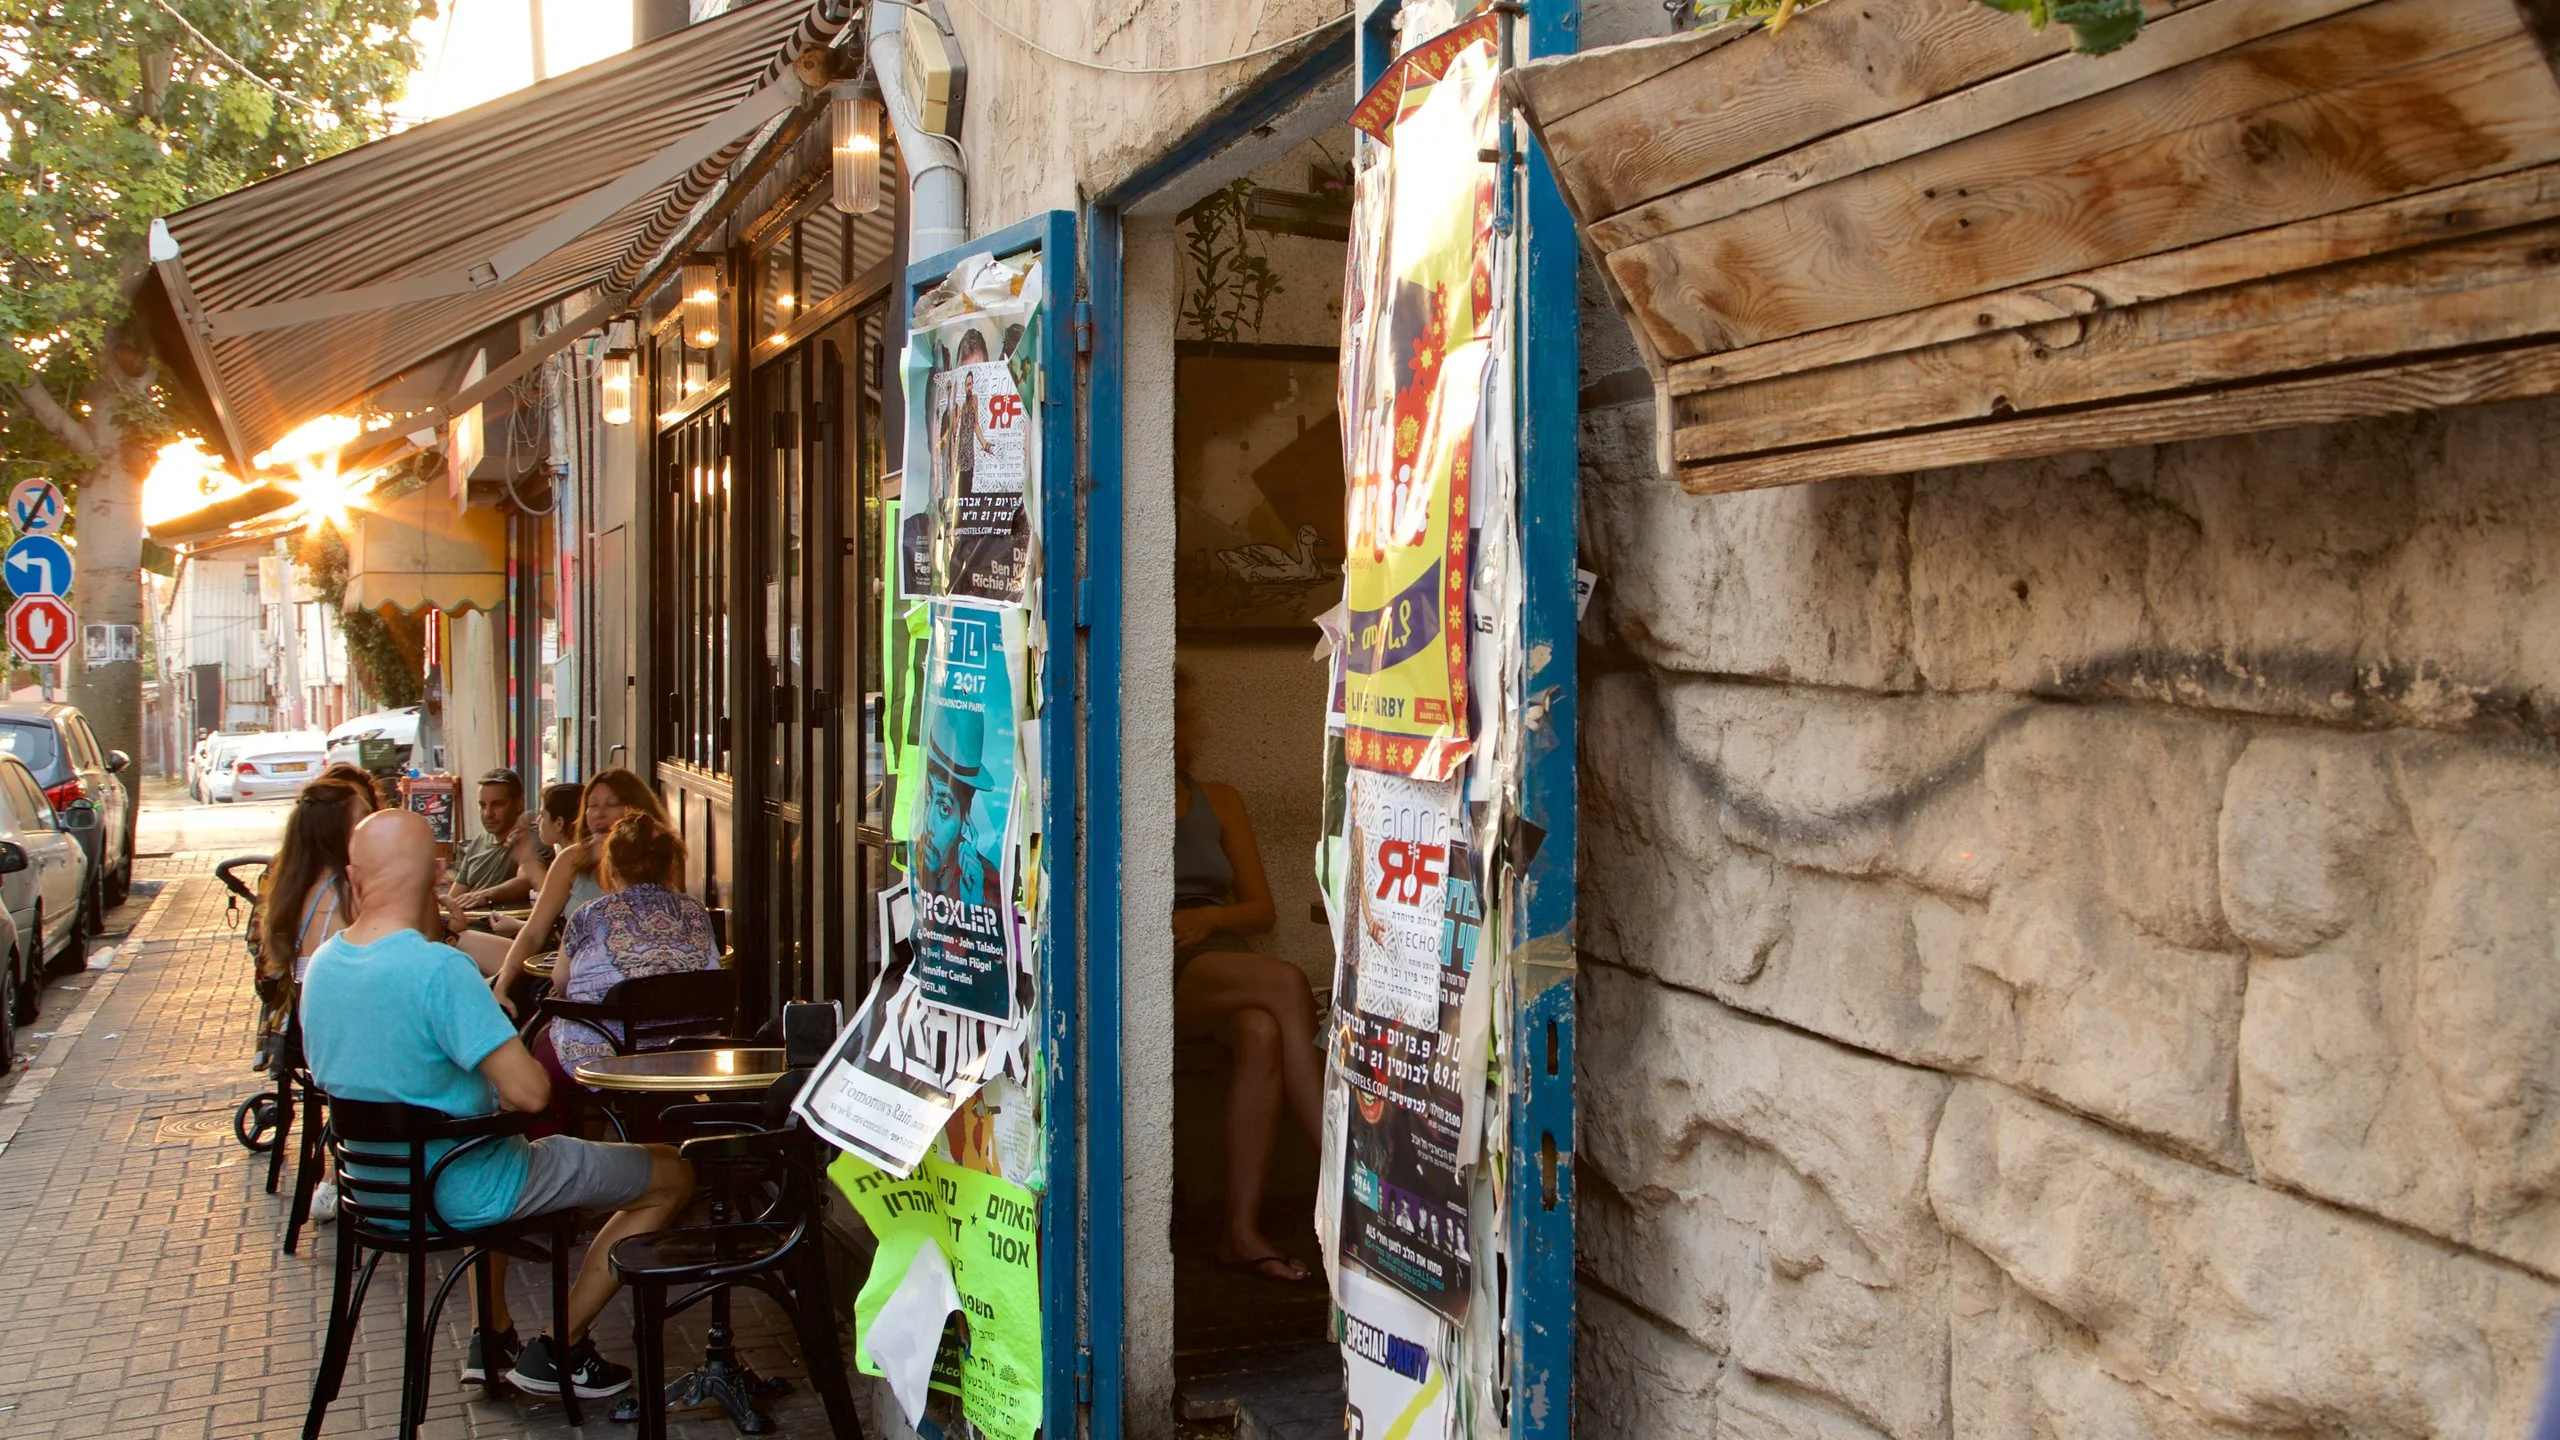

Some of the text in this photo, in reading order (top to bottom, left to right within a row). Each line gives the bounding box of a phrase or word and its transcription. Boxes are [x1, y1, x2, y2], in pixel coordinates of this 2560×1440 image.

[991, 560, 1010, 576] Ben
[972, 573, 1005, 592] Richie
[953, 671, 986, 694] 2017
[1380, 801, 1447, 848] anna
[920, 889, 999, 937] TROXLER
[959, 936, 975, 950] John
[976, 940, 1004, 957] Talabot
[1406, 931, 1435, 953] ECHO
[945, 950, 968, 967] Roman
[969, 957, 992, 973] Flügel
[948, 970, 973, 986] Cardini
[1370, 1049, 1383, 1070] 21
[1387, 1056, 1429, 1086] לבונטין
[892, 1103, 912, 1127] Rain
[1347, 1313, 1387, 1368] SPECIAL
[1387, 1333, 1429, 1385] PARTY
